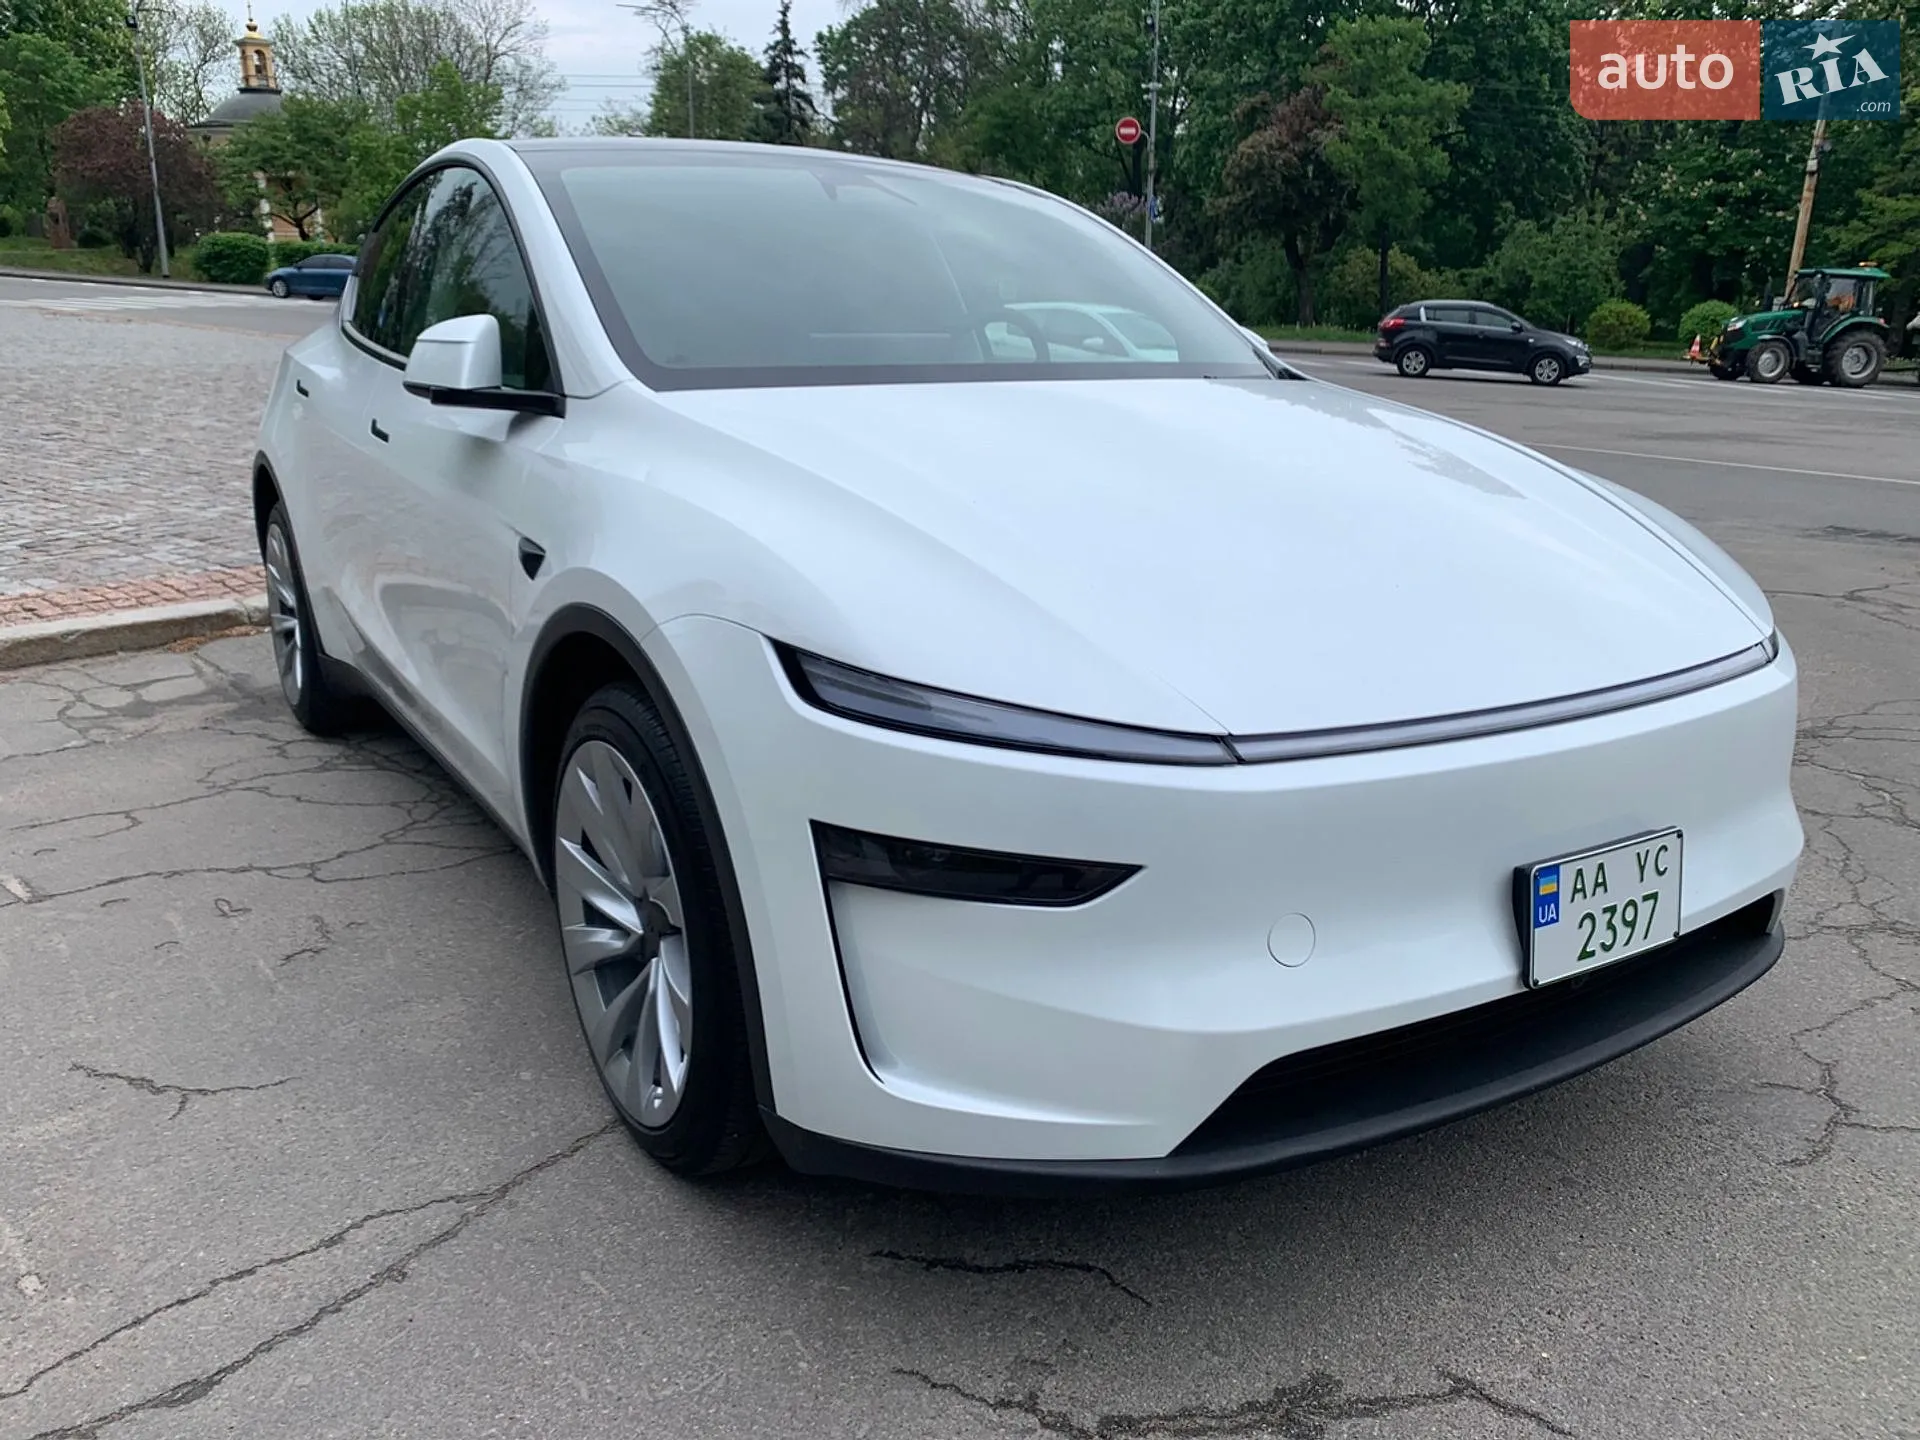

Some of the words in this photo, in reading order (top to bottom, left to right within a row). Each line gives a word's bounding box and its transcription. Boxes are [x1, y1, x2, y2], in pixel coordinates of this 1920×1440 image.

[1570, 862, 1608, 903] AA
[1636, 844, 1668, 883] YC
[1538, 904, 1557, 923] UA
[1577, 891, 1659, 961] 2397
